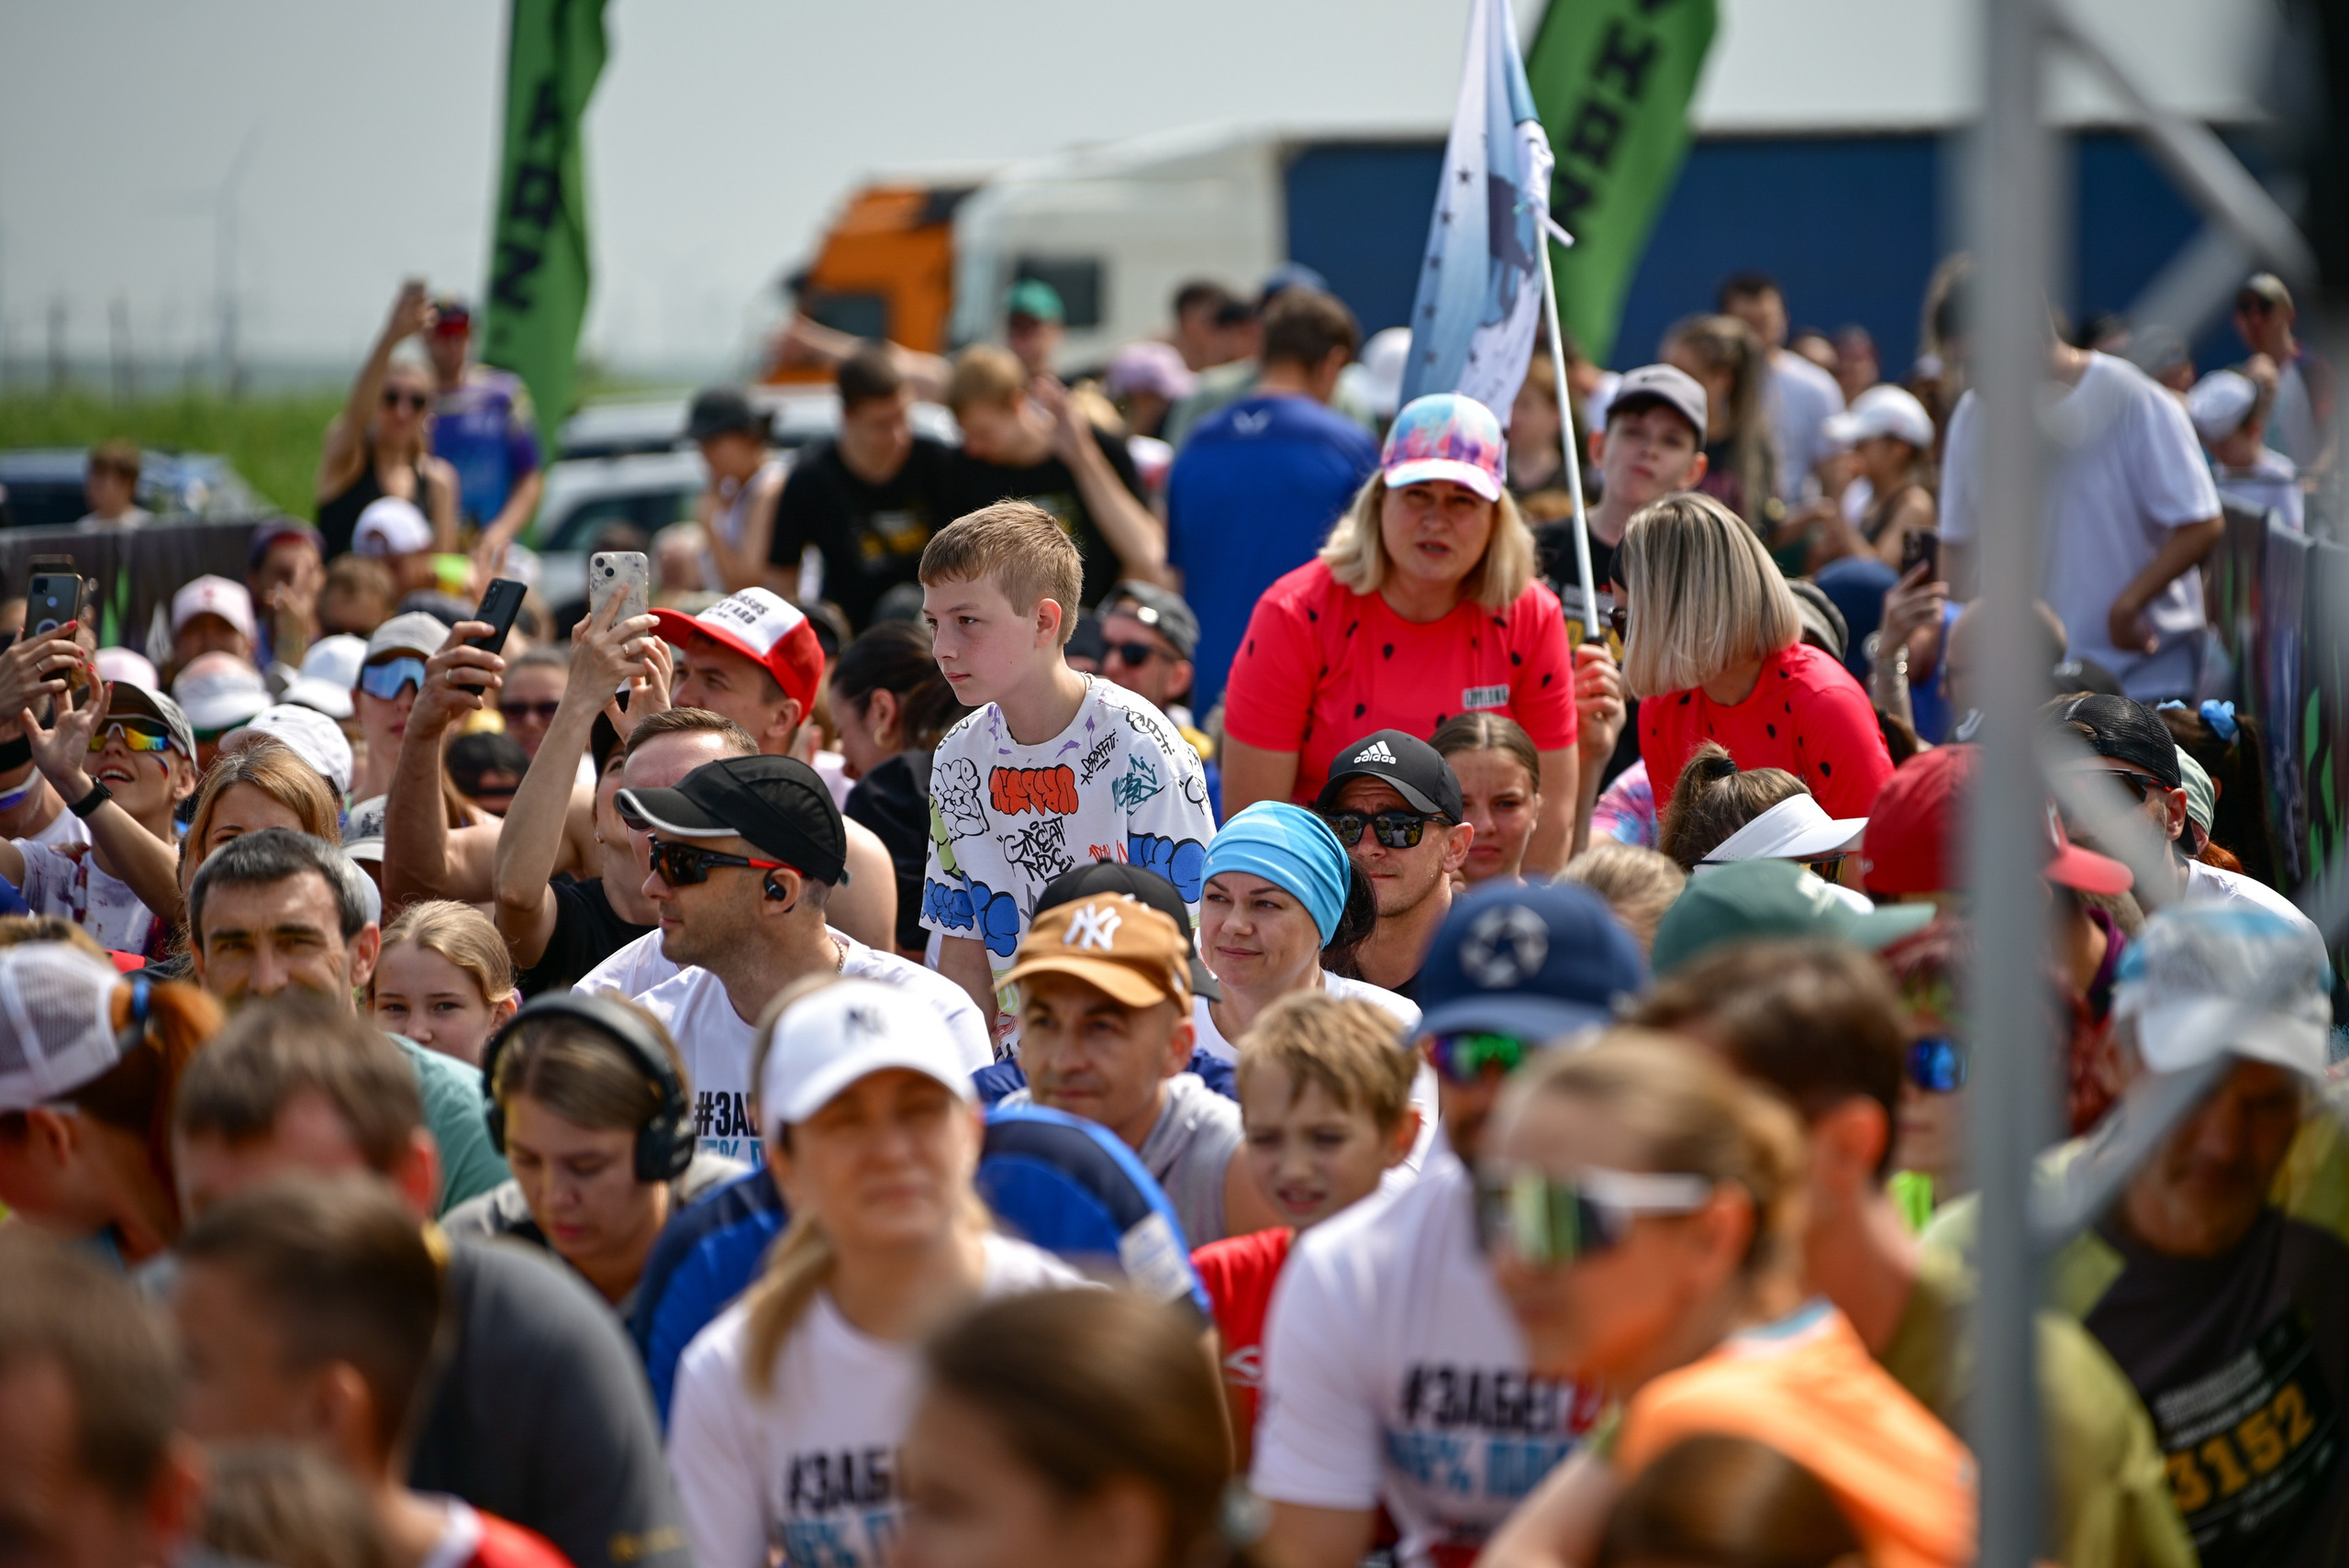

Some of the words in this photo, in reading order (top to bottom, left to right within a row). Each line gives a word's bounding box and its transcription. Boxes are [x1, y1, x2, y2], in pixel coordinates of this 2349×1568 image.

[1353, 752, 1397, 764] adidas
[1063, 903, 1122, 952] NY
[2165, 1379, 2316, 1515] 3152
